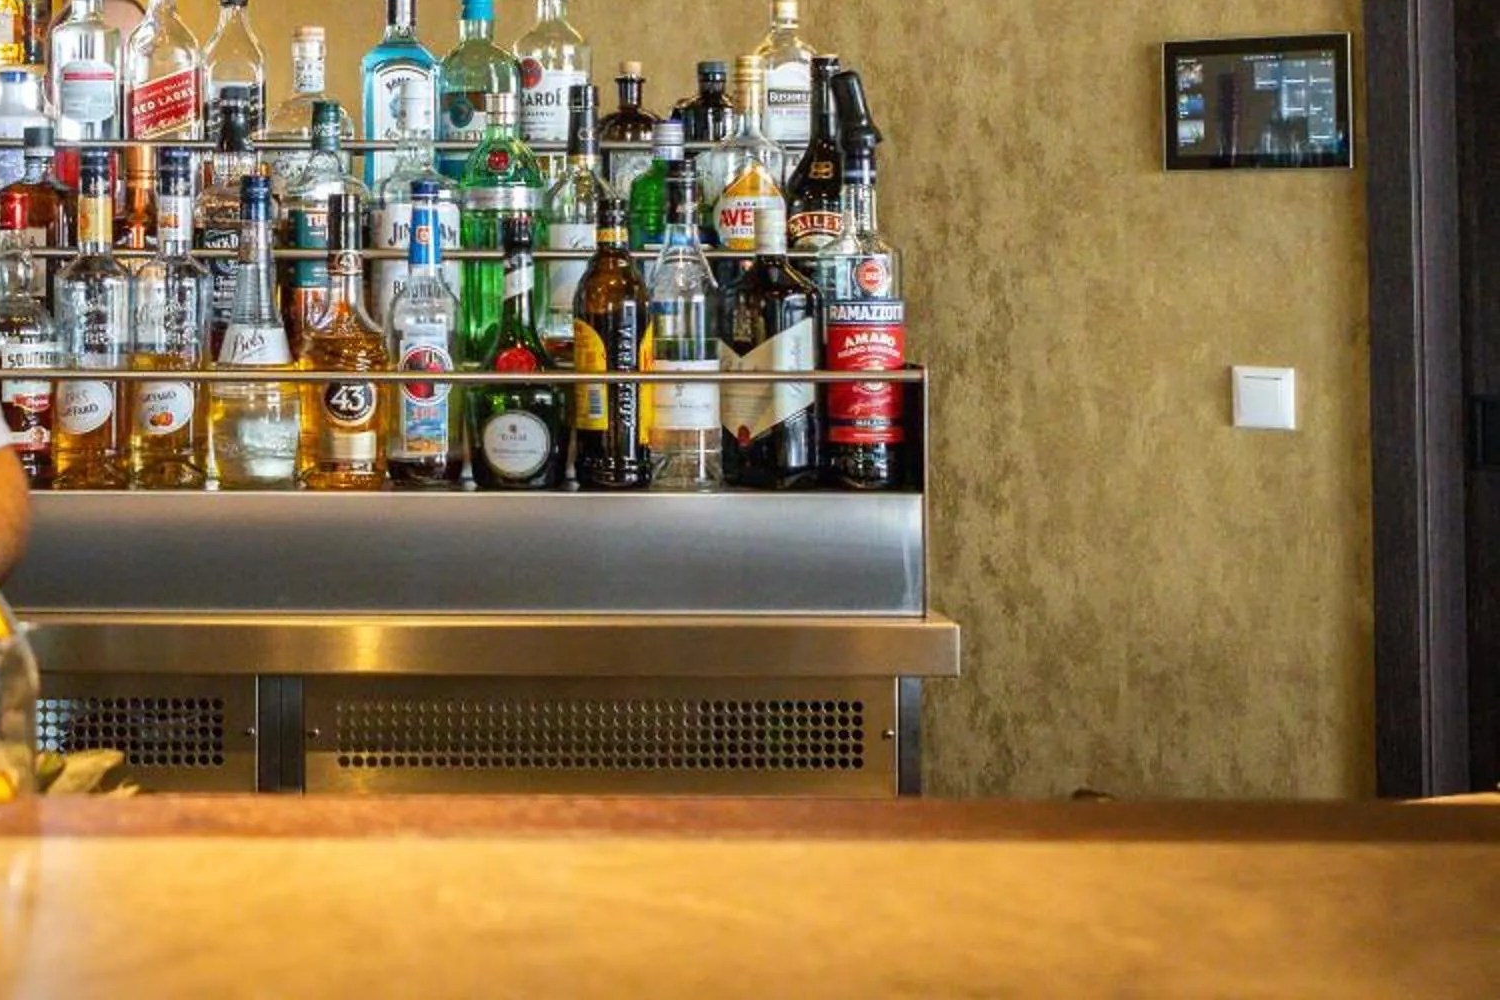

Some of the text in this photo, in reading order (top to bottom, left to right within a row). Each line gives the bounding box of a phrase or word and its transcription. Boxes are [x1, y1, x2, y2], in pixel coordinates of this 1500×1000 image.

[132, 101, 155, 116] RED
[158, 87, 197, 107] LABEL
[520, 87, 561, 107] ARDÍ
[719, 208, 755, 228] AVE
[330, 385, 366, 412] 43
